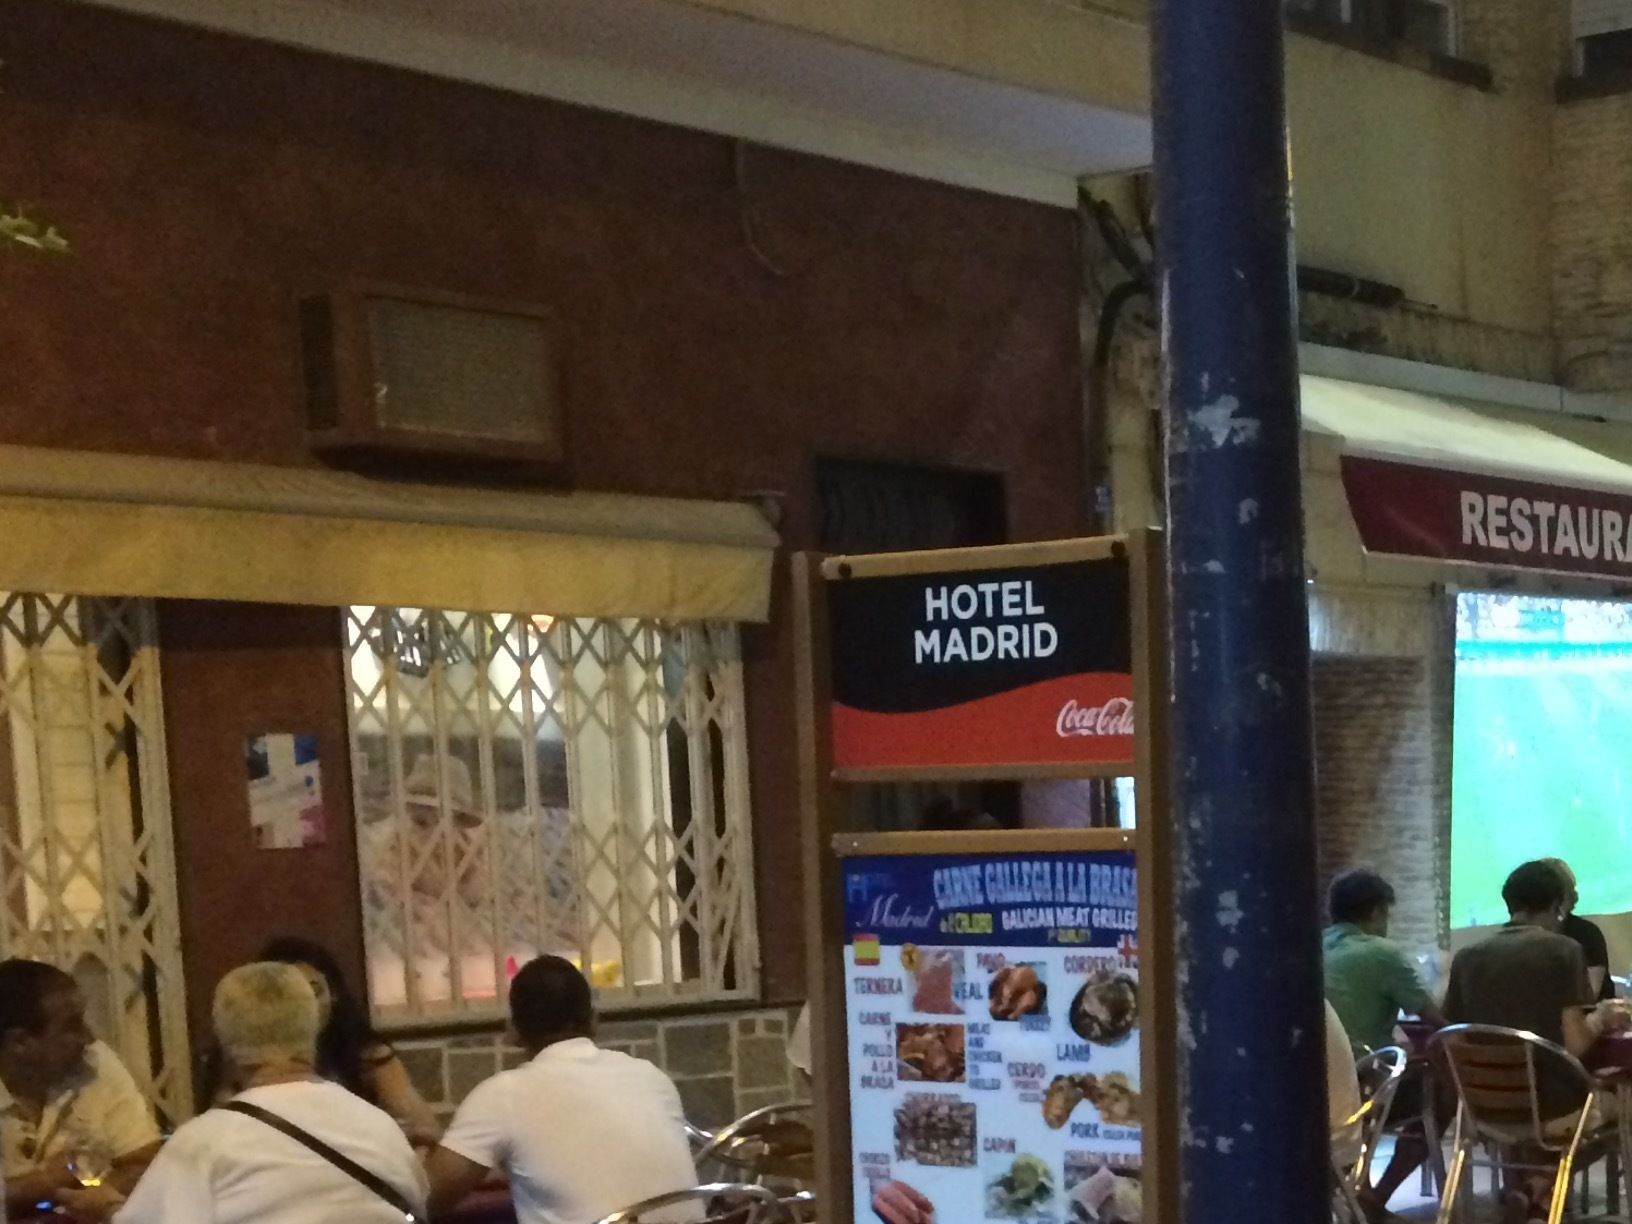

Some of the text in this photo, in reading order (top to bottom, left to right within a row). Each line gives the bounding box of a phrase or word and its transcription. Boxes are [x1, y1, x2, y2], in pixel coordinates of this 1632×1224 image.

[925, 580, 1045, 622] HOTEL
[914, 622, 1058, 665] MADRID
[933, 864, 985, 910] CARNE
[985, 861, 1052, 905] GALLEGA
[1056, 907, 1090, 928] MEAT
